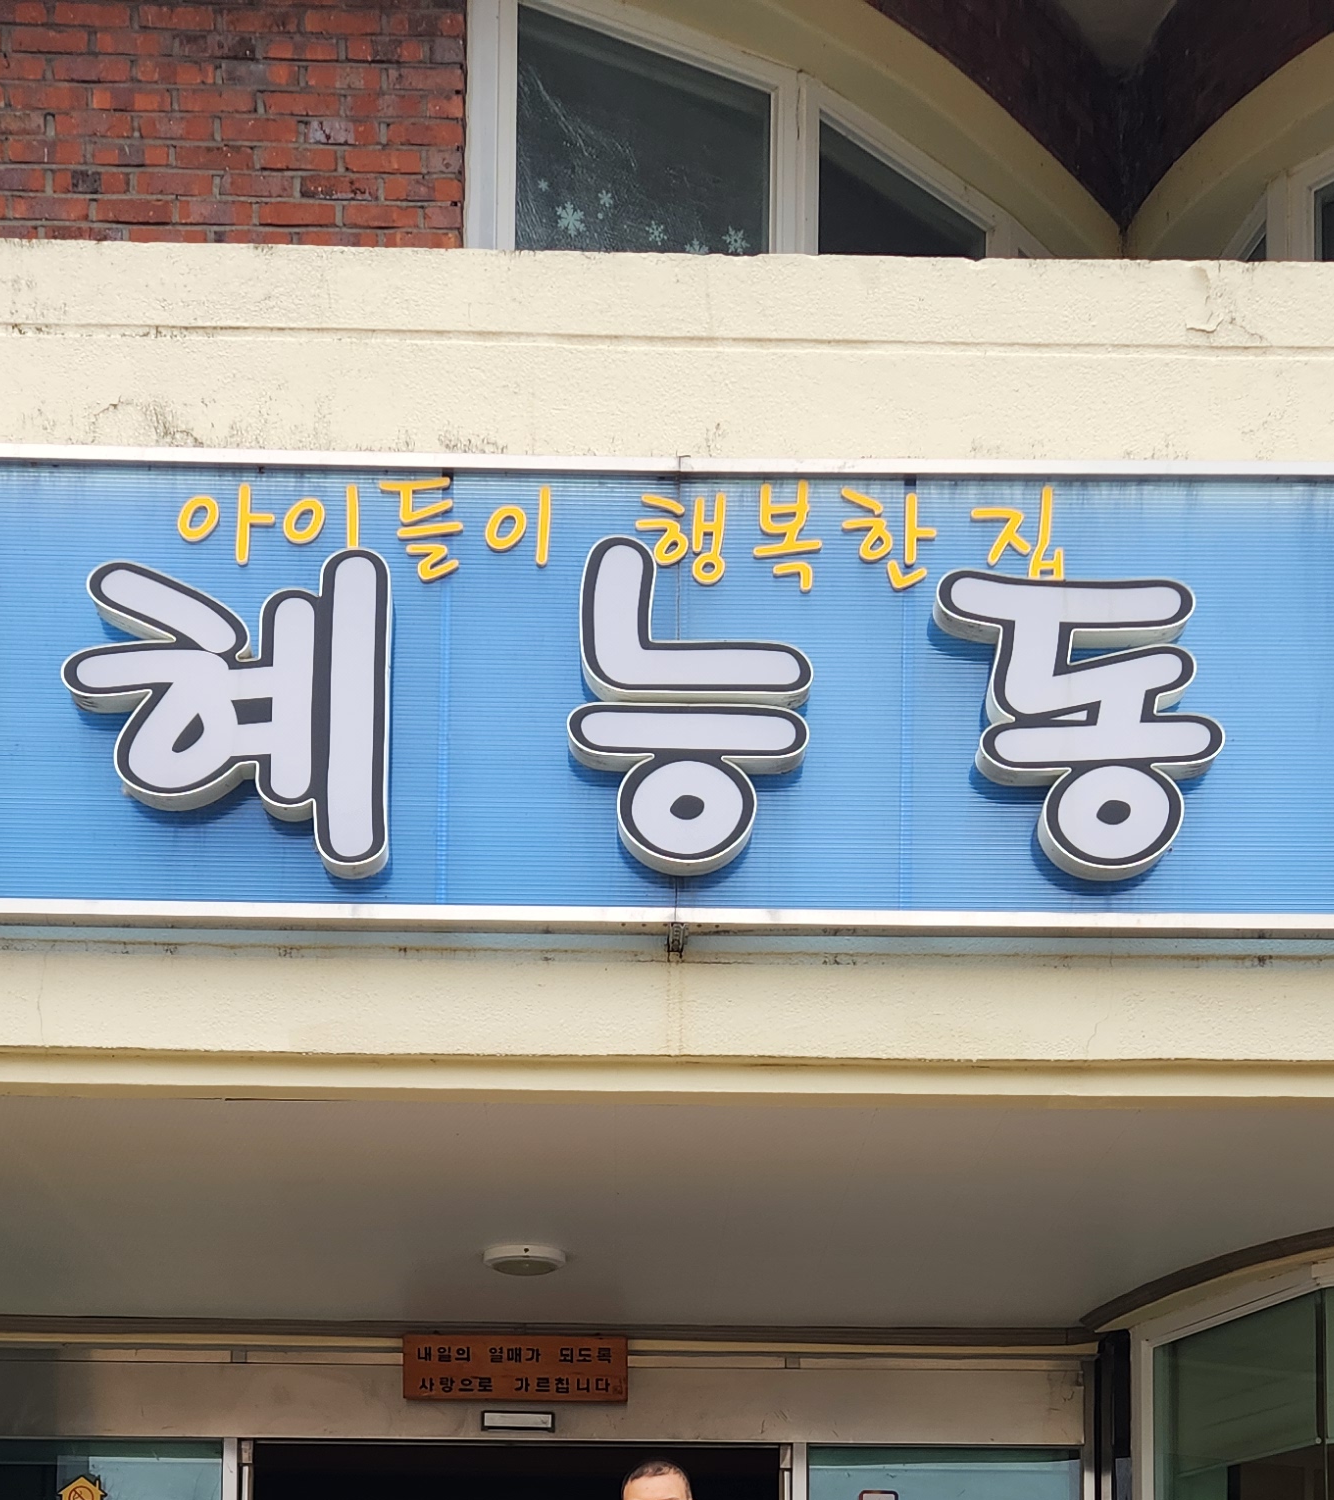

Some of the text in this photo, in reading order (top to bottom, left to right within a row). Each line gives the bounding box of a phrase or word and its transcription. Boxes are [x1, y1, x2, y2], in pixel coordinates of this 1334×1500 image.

[176, 475, 1064, 591] 아이들이 행복한 집
[417, 1346, 612, 1364] 내일의 열매가 되도록
[419, 1377, 611, 1394] 사랑으로 가르칩니다
